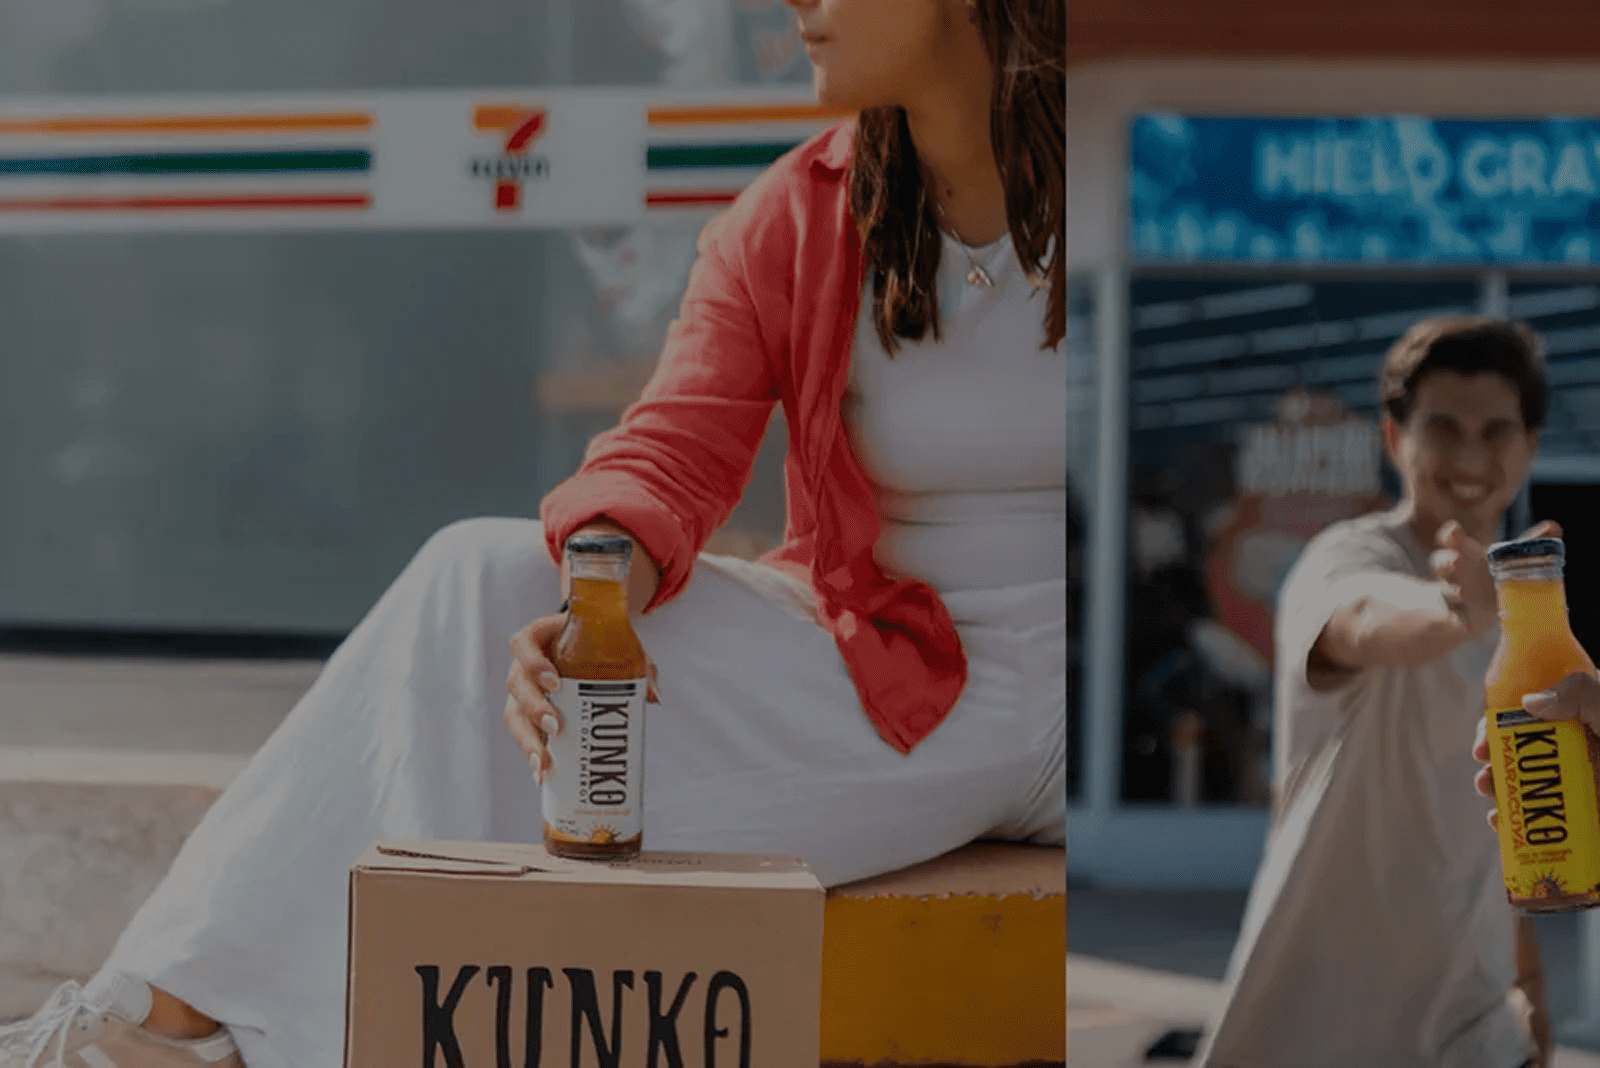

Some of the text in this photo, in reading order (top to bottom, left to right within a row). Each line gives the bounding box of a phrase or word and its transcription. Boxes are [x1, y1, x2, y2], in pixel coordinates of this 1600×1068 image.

[473, 105, 545, 211] 7
[1258, 138, 1449, 198] HIELO
[578, 756, 589, 804] ENERGY
[580, 727, 589, 749] DAY
[589, 700, 629, 806] KUNKO
[1513, 726, 1568, 847] KUNKO
[414, 964, 752, 1068] KUNKO
